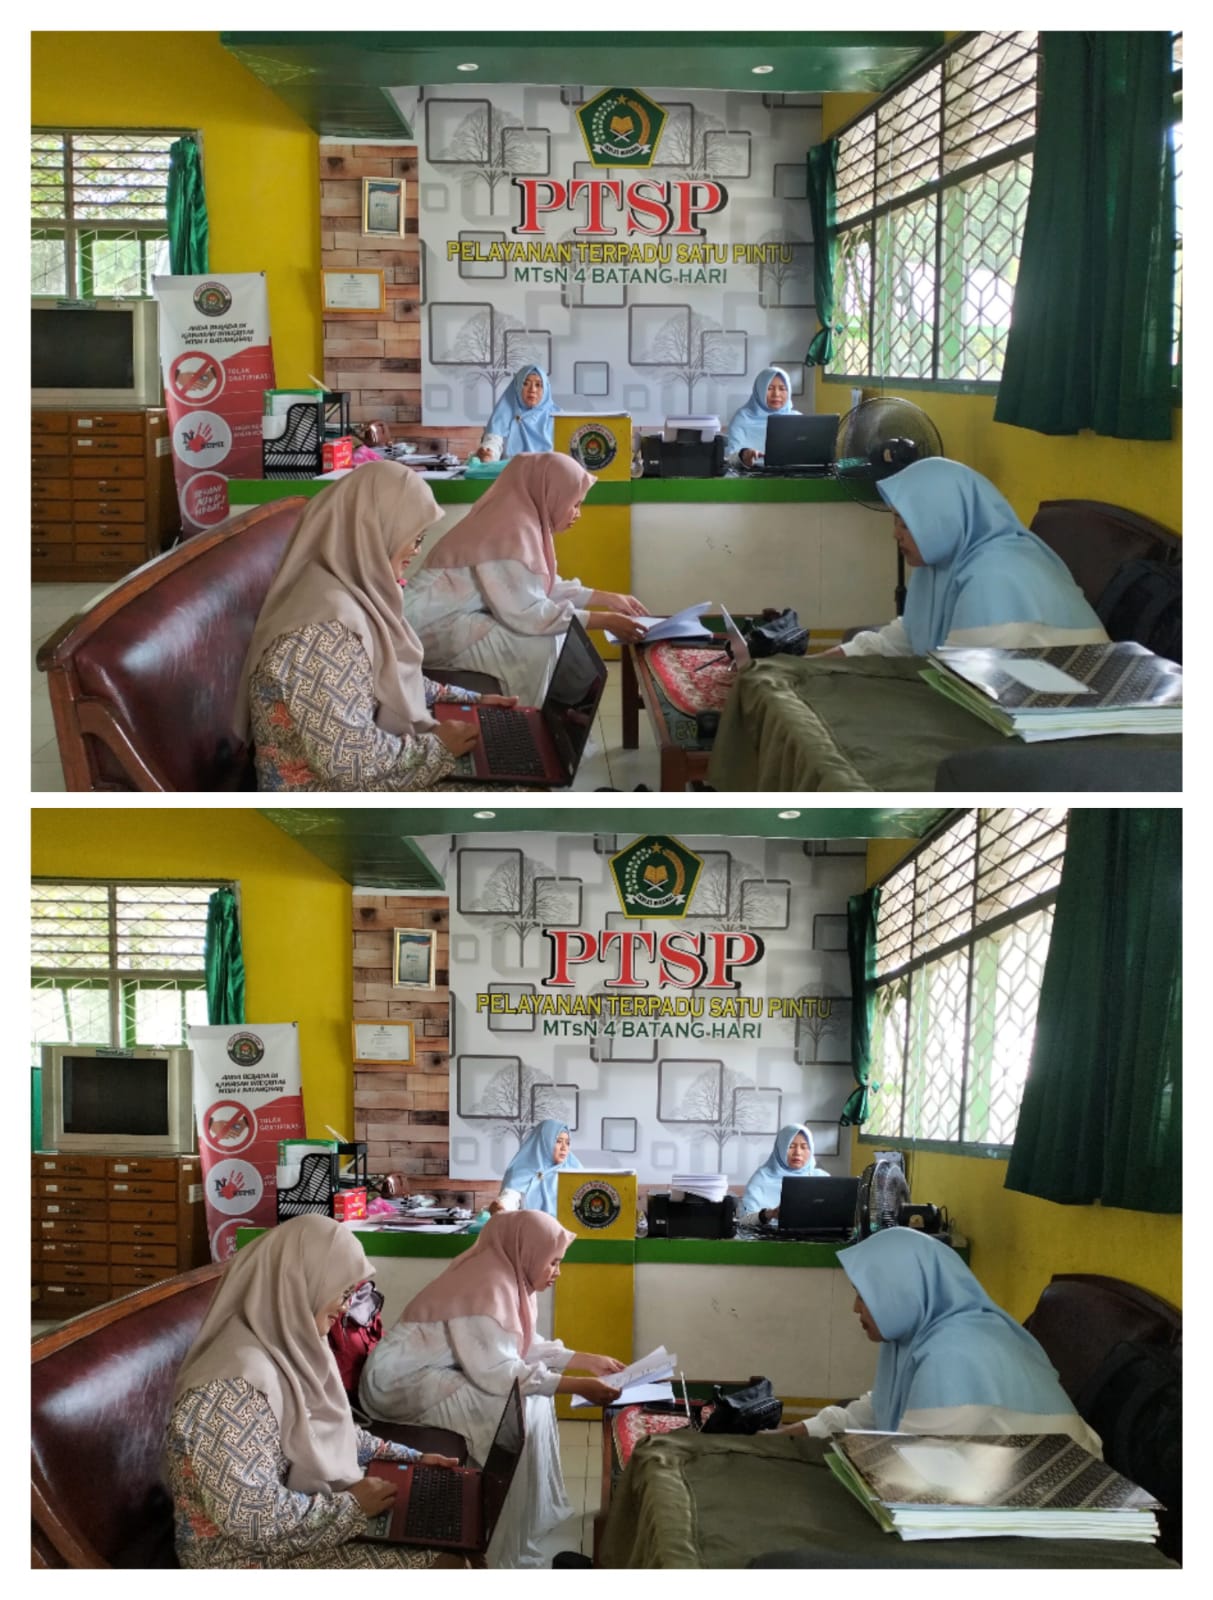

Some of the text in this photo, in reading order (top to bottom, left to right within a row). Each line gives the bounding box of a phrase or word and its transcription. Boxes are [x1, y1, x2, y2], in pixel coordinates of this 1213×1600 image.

[511, 177, 729, 236] PTSP
[446, 240, 793, 264] PELAYANAN TERPADU SATU PINTU
[514, 267, 568, 283] MTsN
[574, 267, 586, 283] 4
[541, 929, 765, 989] PTSP
[476, 993, 832, 1018] PELAYANAN TERPADU SATU PINTU
[543, 1020, 597, 1036] MTsN
[604, 1021, 616, 1037] 4
